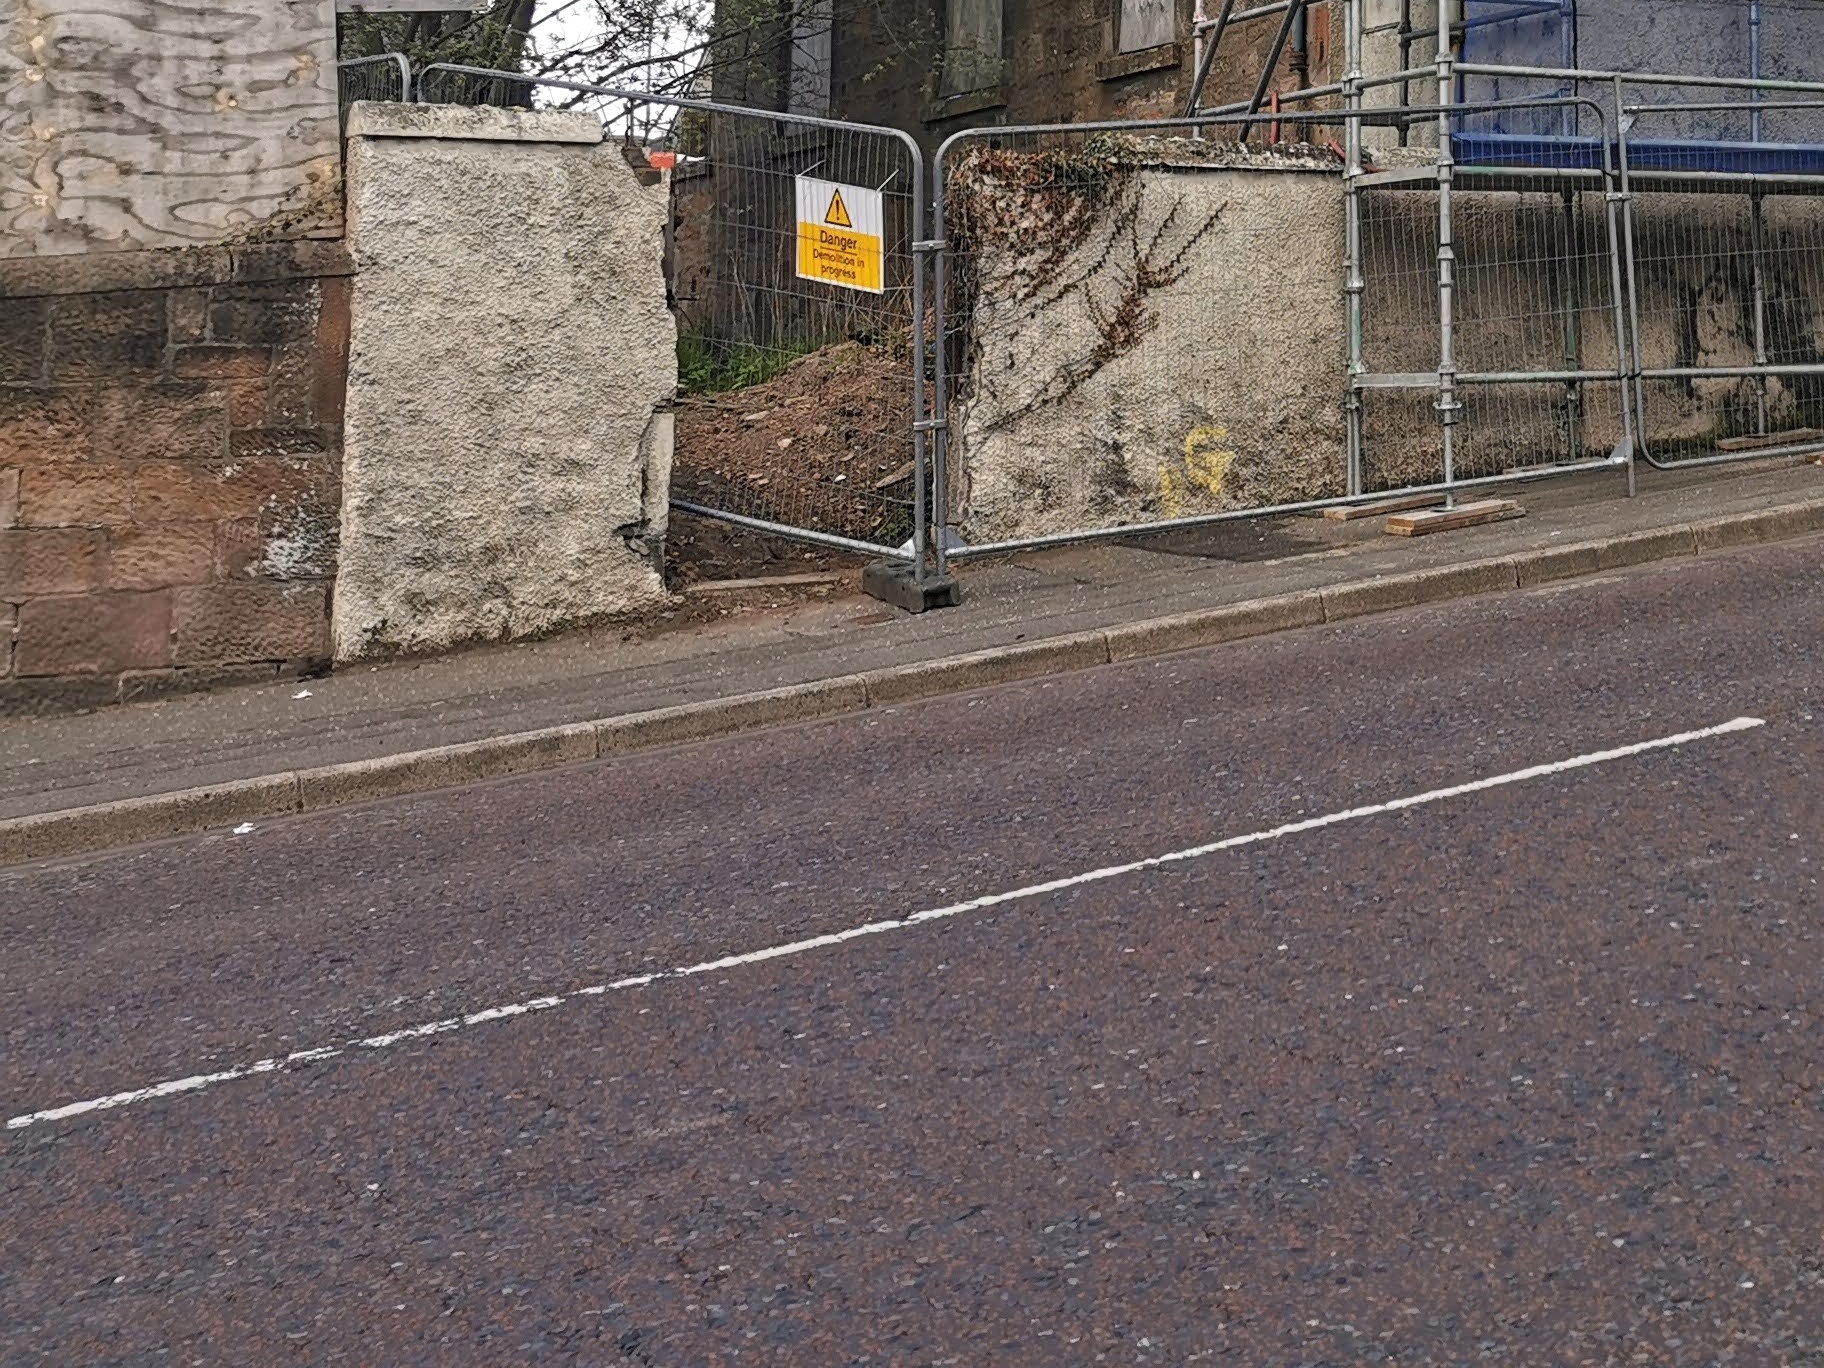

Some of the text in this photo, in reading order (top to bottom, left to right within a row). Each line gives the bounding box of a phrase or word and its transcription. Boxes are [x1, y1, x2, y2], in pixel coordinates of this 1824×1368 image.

[820, 230, 857, 251] Danger
[813, 248, 865, 268] Demolition in
[821, 264, 856, 280] progress
